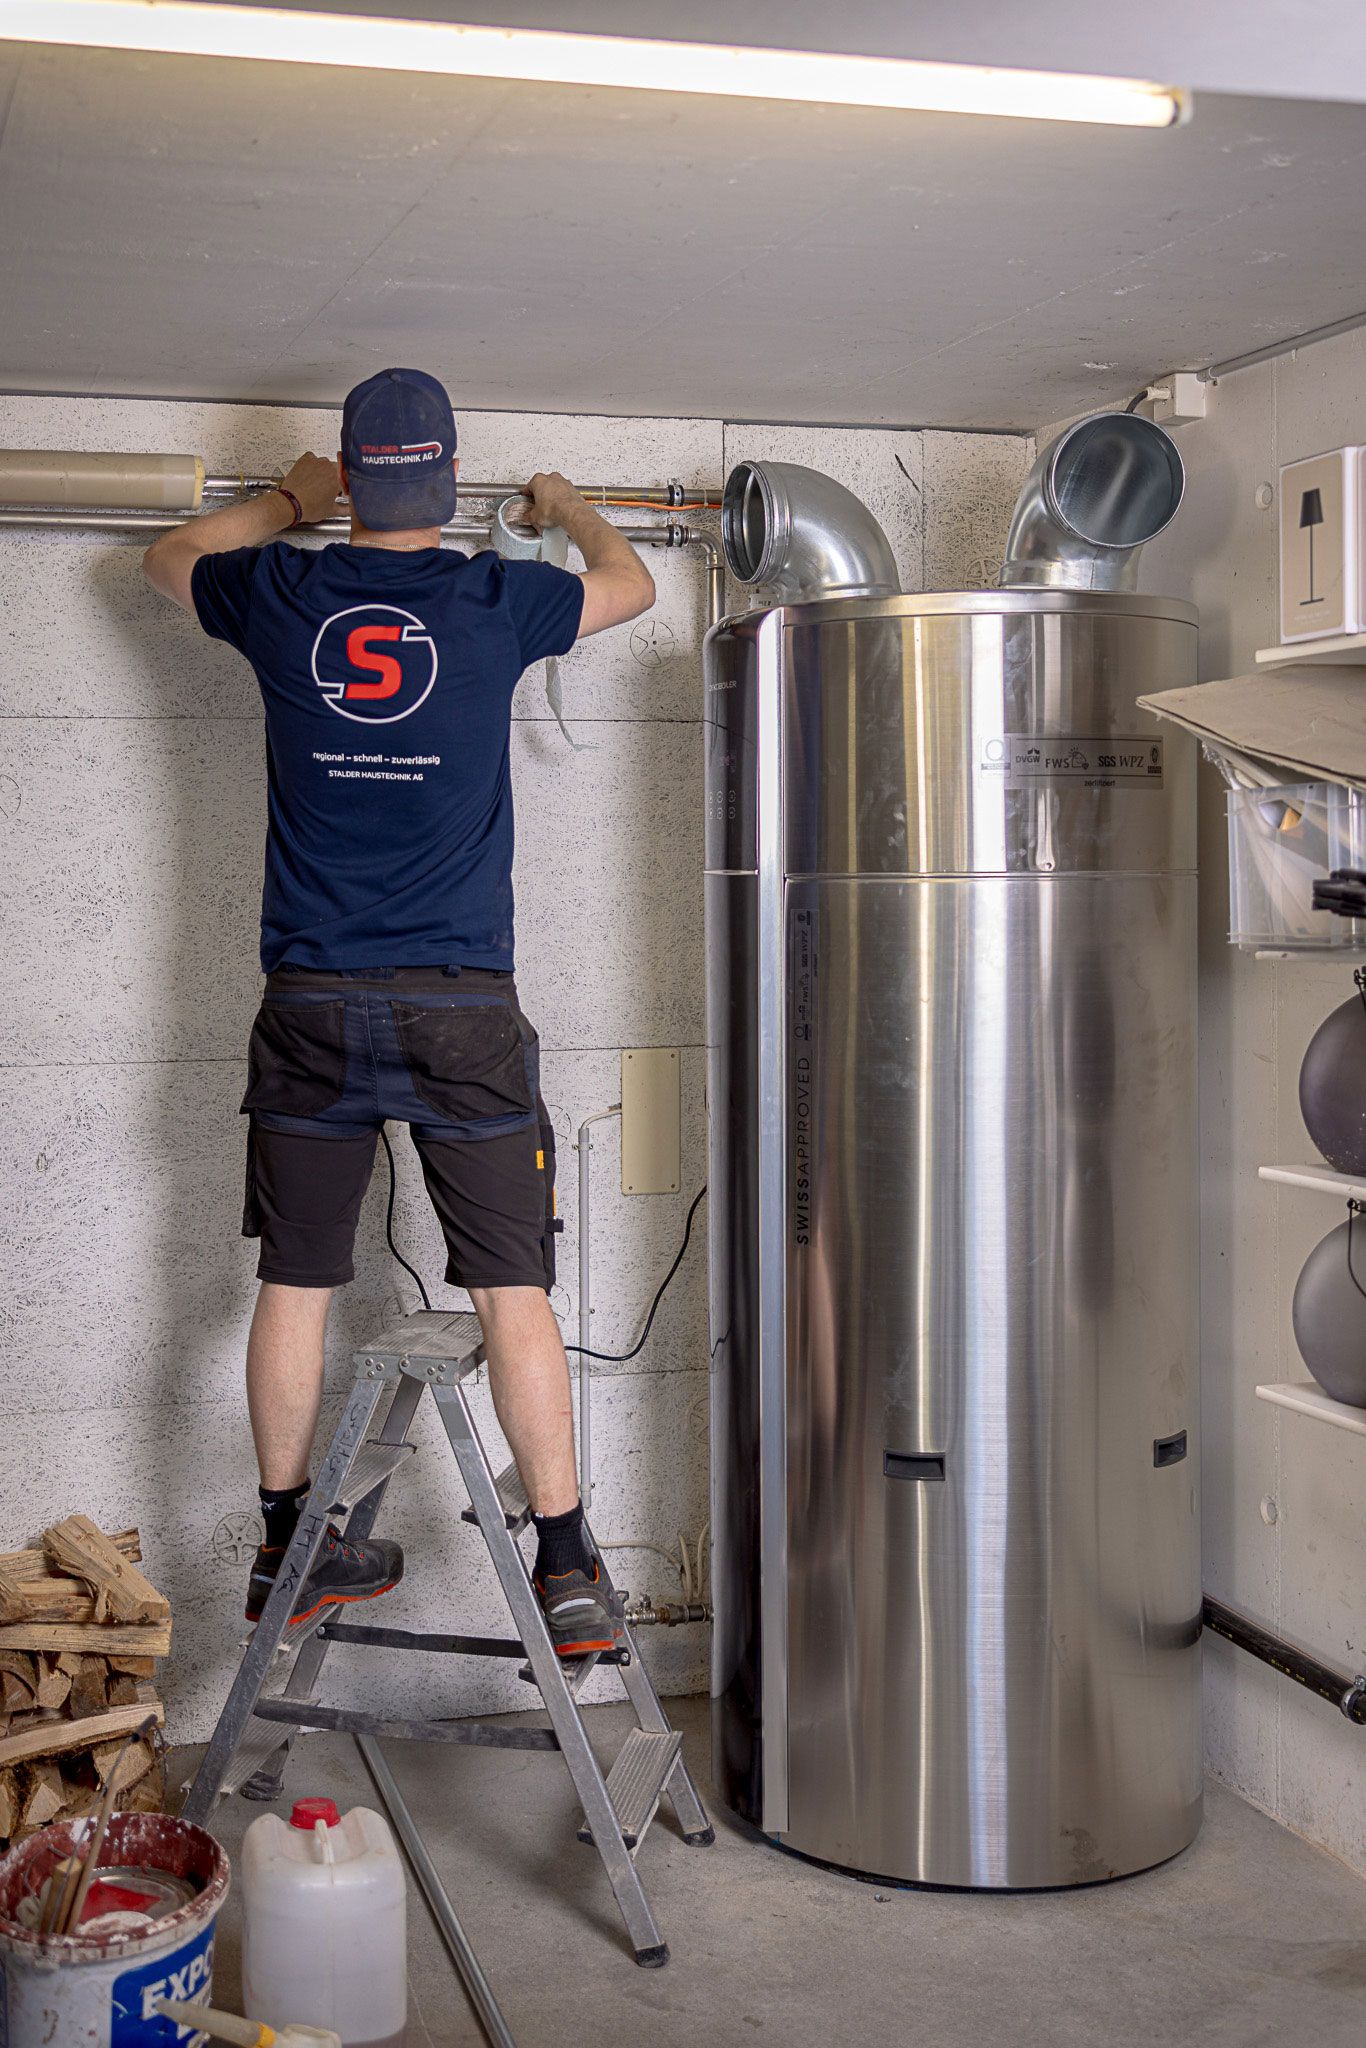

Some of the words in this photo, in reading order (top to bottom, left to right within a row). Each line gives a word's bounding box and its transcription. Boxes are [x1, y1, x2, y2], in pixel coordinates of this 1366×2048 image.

[362, 454, 421, 465] HAUSTECHNIK
[422, 452, 433, 462] AG
[345, 625, 403, 700] S
[313, 752, 345, 762] regional
[353, 754, 383, 763] schnell
[391, 755, 441, 766] zuverlässig
[1015, 755, 1041, 764] DVGW
[1045, 758, 1070, 769] FWS
[1098, 755, 1116, 768] SGS
[1119, 755, 1144, 768] WPZ
[328, 769, 361, 779] STALDER
[361, 771, 412, 781] HAUSTECHNIK
[412, 773, 424, 781] AG
[797, 1057, 810, 1246] SWISSAPPROVED
